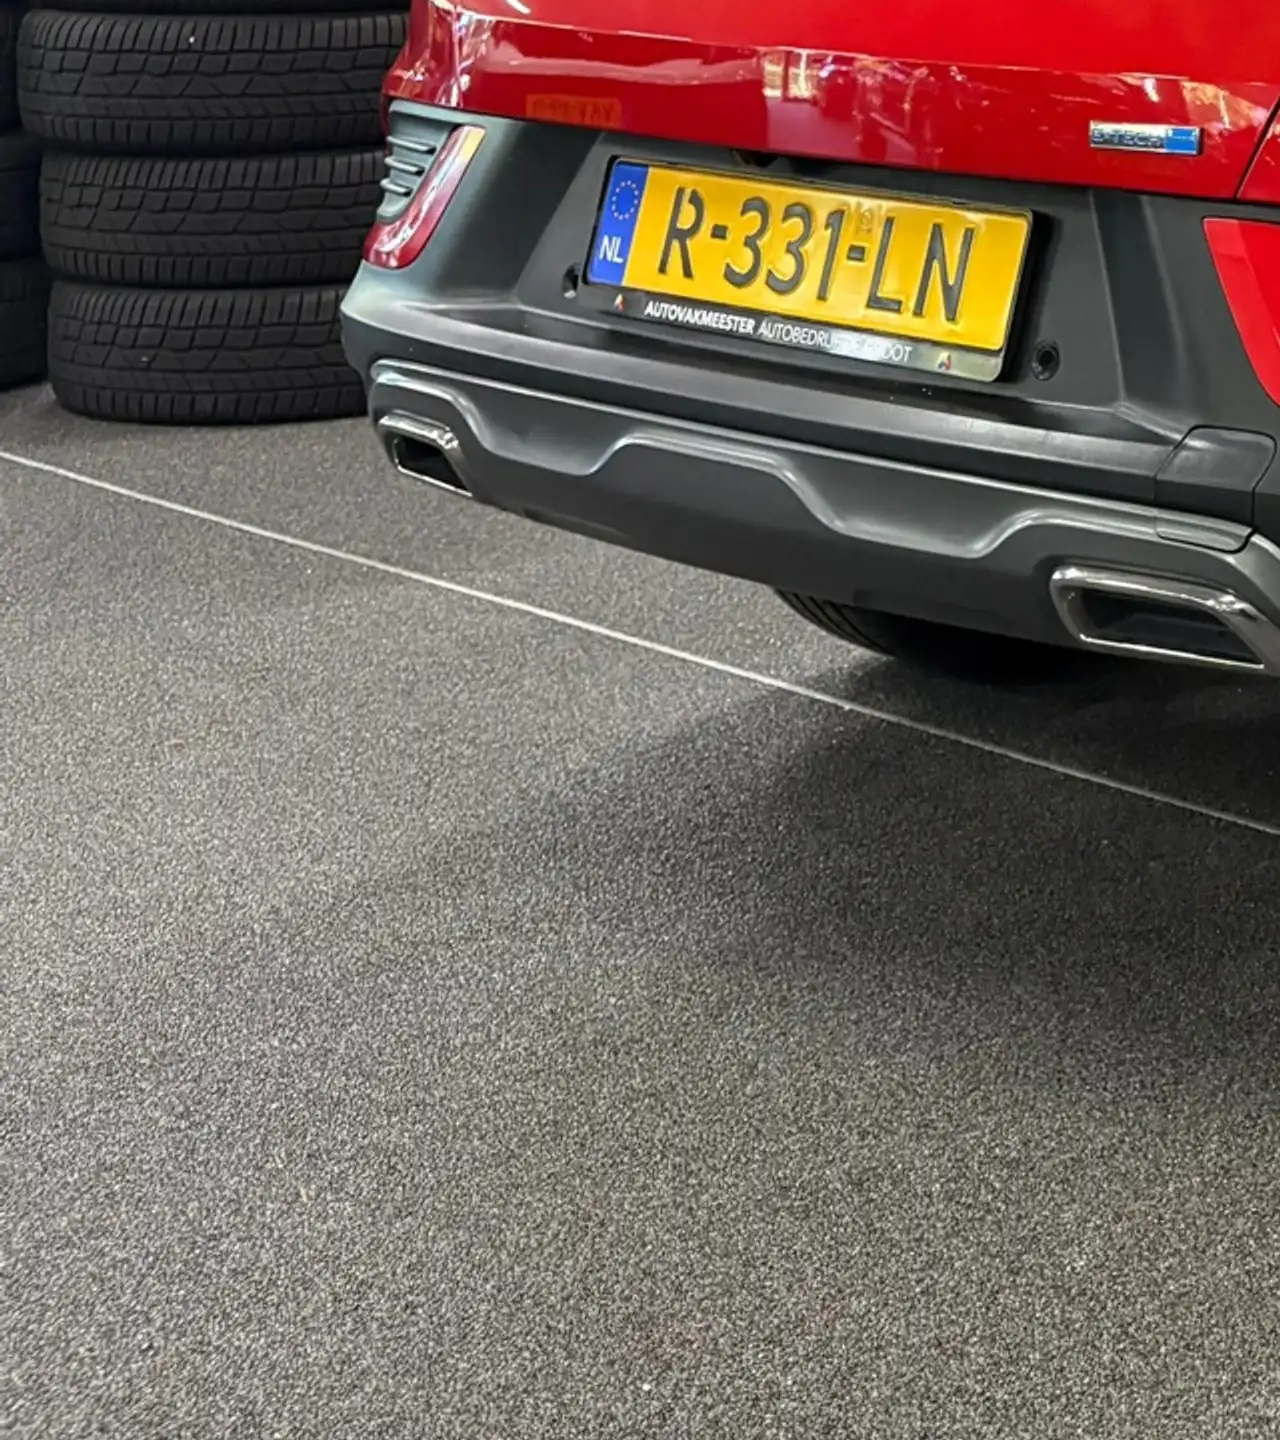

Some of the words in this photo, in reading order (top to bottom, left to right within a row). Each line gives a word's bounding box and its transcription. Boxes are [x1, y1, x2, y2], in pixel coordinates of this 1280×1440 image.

[599, 234, 625, 263] NL
[657, 185, 976, 324] R-331-LN
[643, 300, 756, 335] AUTOVAKMEESTER
